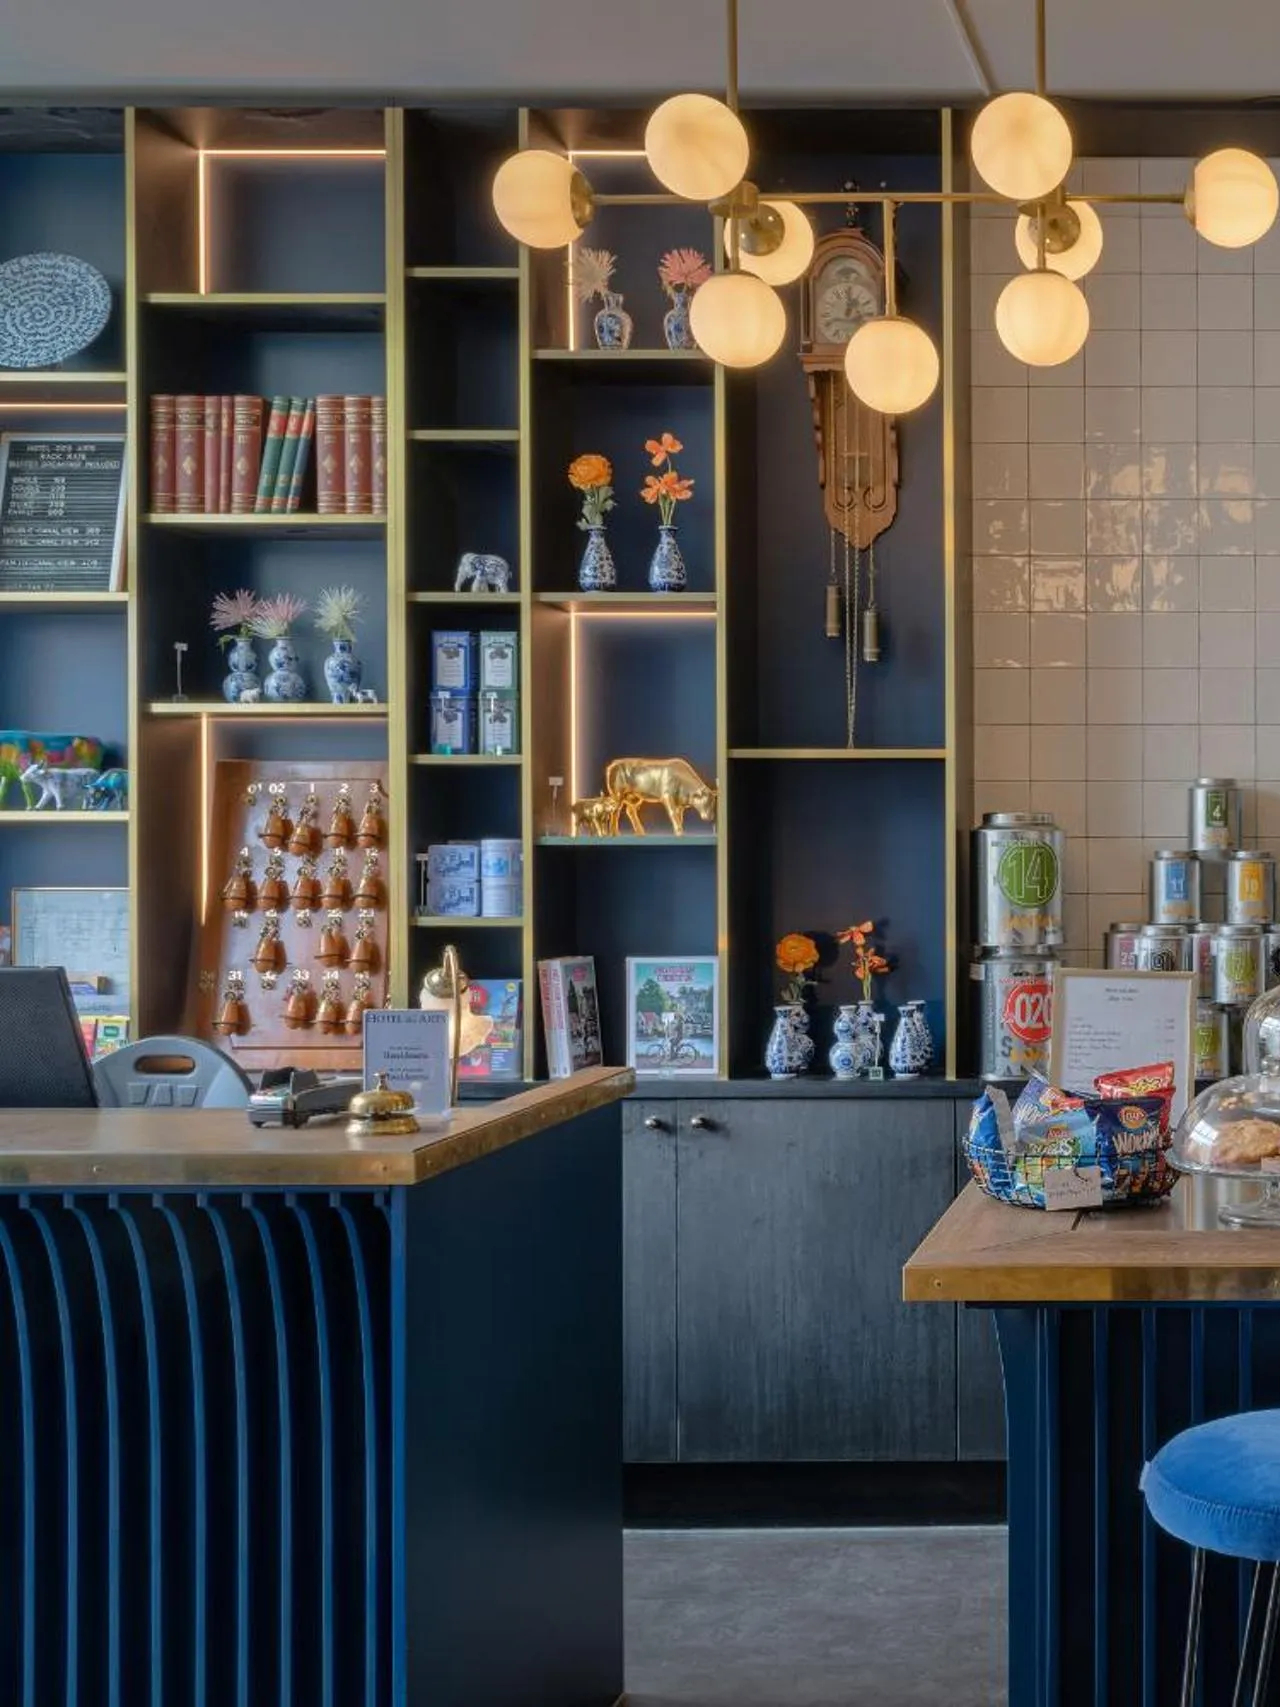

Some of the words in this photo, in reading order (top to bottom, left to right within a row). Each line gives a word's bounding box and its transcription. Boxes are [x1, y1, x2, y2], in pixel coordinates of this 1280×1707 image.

[268, 783, 286, 793] 02
[339, 783, 349, 793] 2
[369, 783, 379, 793] 3
[1212, 804, 1221, 819] 4
[365, 847, 378, 856] 12
[1008, 847, 1048, 899] 14
[228, 970, 242, 981] 31
[292, 969, 310, 981] 33
